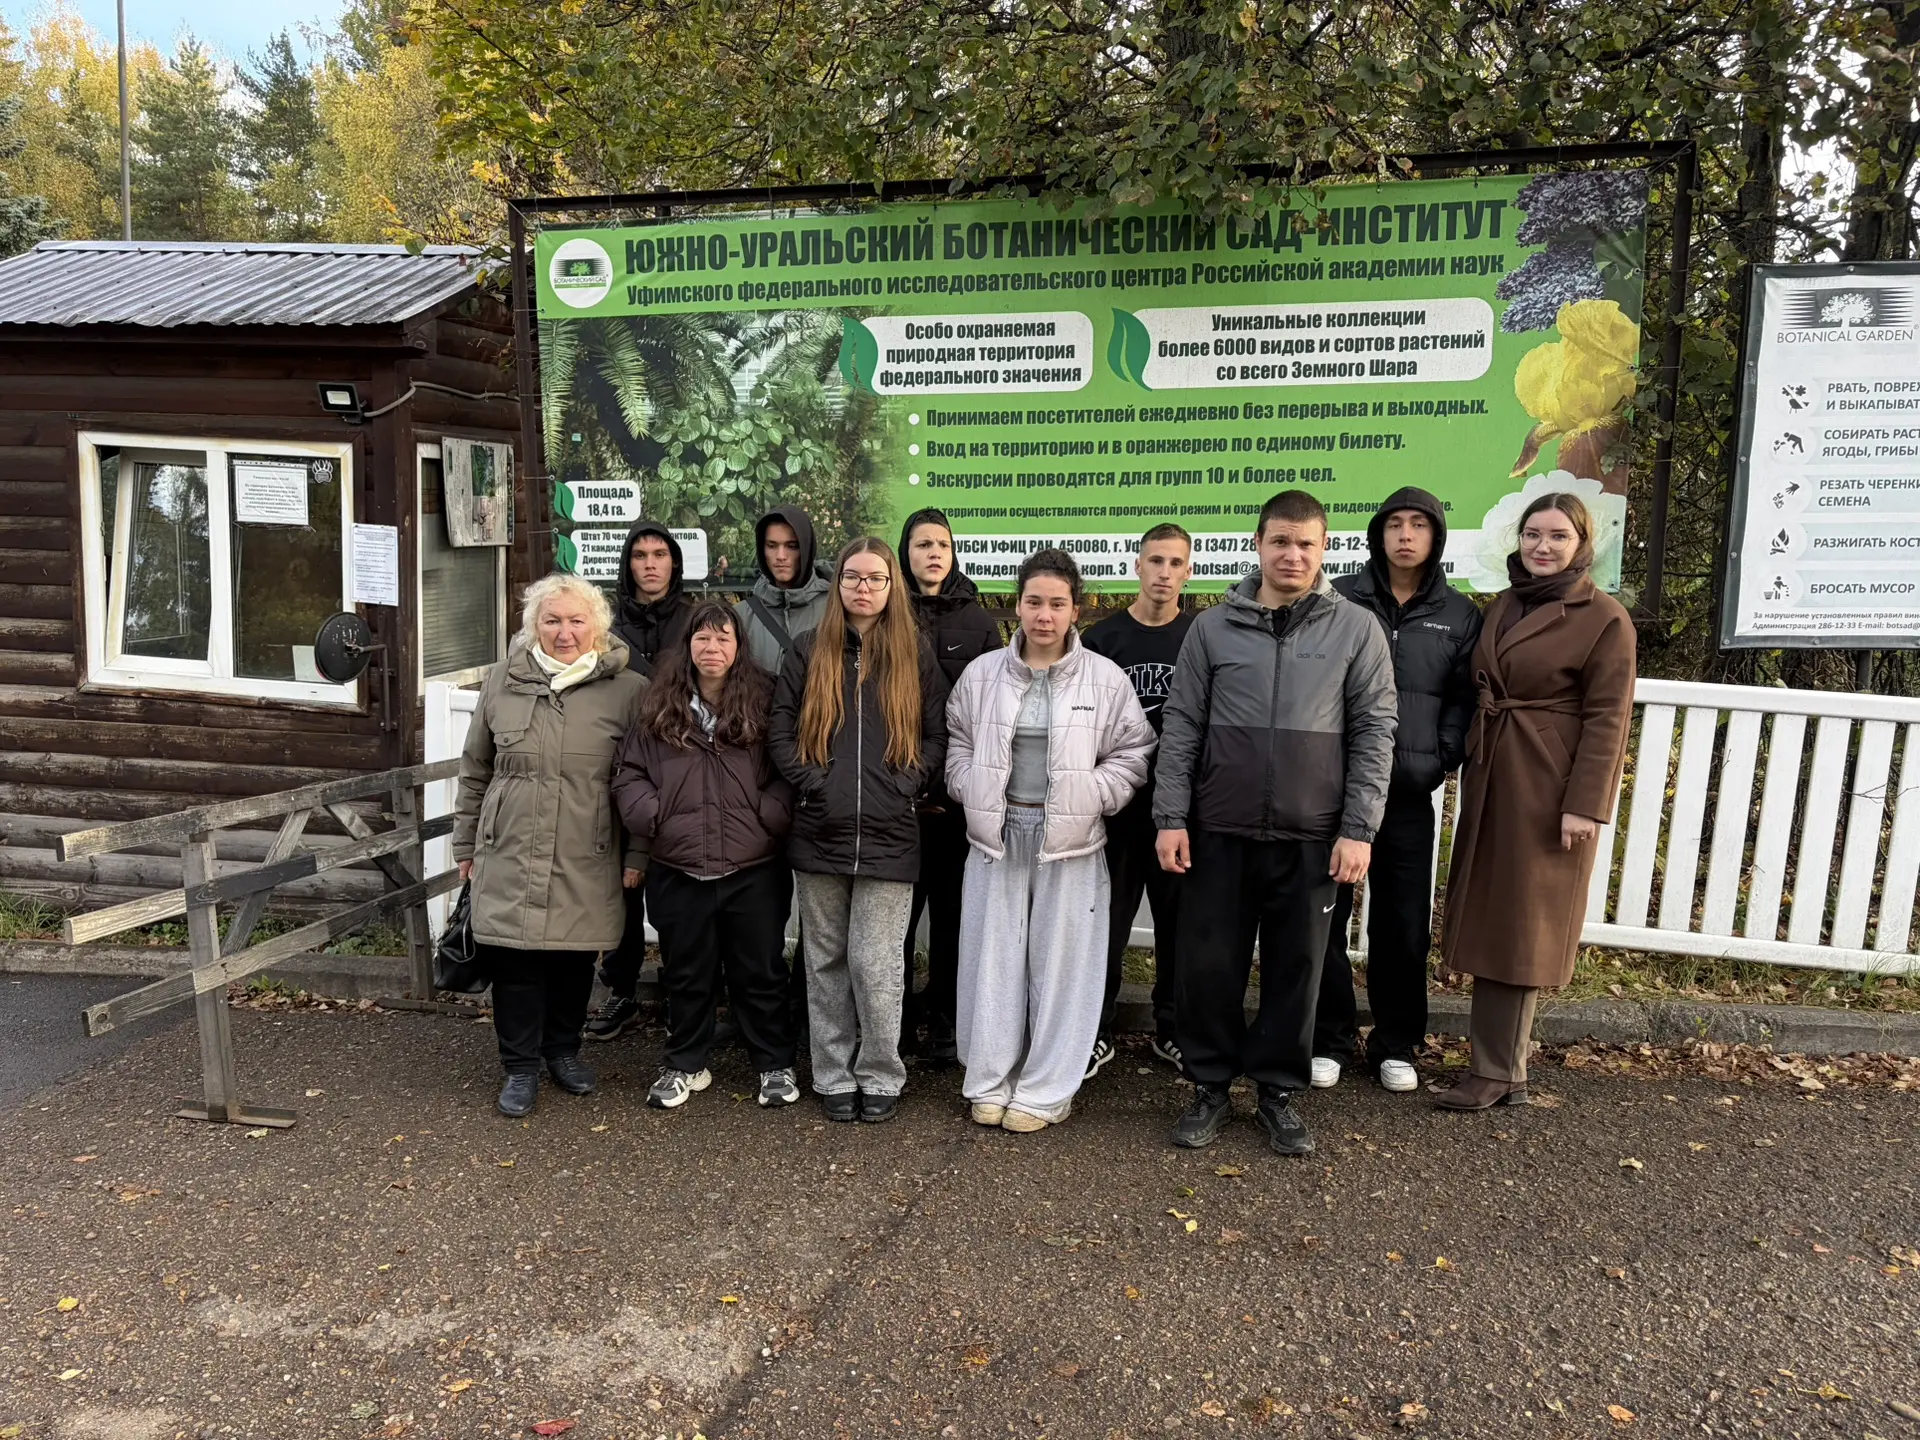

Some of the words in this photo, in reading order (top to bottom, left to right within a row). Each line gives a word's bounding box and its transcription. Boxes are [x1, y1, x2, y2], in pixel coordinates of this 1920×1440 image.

[624, 217, 934, 275] ЮЖНО-УРАЛЬСКИЙ
[1226, 199, 1508, 254] САД-ИНСТИТУТ
[626, 284, 734, 307] Уфимского
[738, 276, 883, 302] федерального
[887, 269, 1106, 296] исследовательского
[1111, 266, 1187, 290] центра
[1191, 257, 1324, 285] Российской
[1328, 258, 1445, 281] академии
[1450, 254, 1505, 276] наук
[1211, 312, 1323, 332] Уникальные
[1326, 309, 1427, 328] коллекции
[905, 322, 954, 340] Особо
[956, 321, 1056, 340] охраняемая
[1776, 329, 1853, 344] BOTANICAL
[1855, 329, 1914, 342] GARDEN
[1158, 339, 1210, 357] более
[1213, 337, 1257, 356] 6000
[1260, 338, 1316, 356] видов
[1319, 337, 1331, 353] и
[1334, 335, 1395, 354] сортов
[1398, 329, 1486, 351] растений
[886, 346, 976, 364] природная
[979, 344, 1076, 362] территория
[1216, 363, 1237, 380] со
[1240, 362, 1288, 380] всего
[1291, 359, 1365, 379] Земного
[1368, 358, 1418, 377] Шара
[879, 369, 999, 388] федерального
[1002, 367, 1082, 384] значения
[1827, 382, 1871, 394] РВАТЬ,
[1826, 400, 1836, 410] И
[926, 409, 1023, 428] Принимаем
[1026, 405, 1136, 426] посетителей
[1138, 403, 1240, 423] ежедневно
[1242, 401, 1274, 420] без
[1277, 400, 1368, 420] перерыва
[1371, 400, 1384, 416] и
[1387, 399, 1489, 418] выходных.
[1823, 429, 1890, 440] СОБИРАТЬ
[926, 440, 967, 458] Вход
[969, 441, 989, 457] на
[992, 440, 1095, 458] территорию
[1097, 439, 1109, 455] и
[1112, 439, 1123, 454] в
[1125, 436, 1228, 455] оранжерею
[1231, 437, 1253, 452] по
[1256, 434, 1336, 453] единому
[1339, 432, 1406, 450] билету.
[1821, 446, 1872, 459] ЯГОДЫ,
[1874, 445, 1919, 456] ГРИБЫ
[926, 471, 1013, 489] Экскурсии
[1016, 470, 1116, 489] проводятся
[1118, 470, 1151, 487] для
[1155, 469, 1203, 486] групп
[1205, 467, 1225, 484] 10
[1227, 468, 1240, 484] и
[1243, 466, 1297, 483] более
[1299, 467, 1337, 483] чел.
[1819, 479, 1865, 490] РЕЗАТЬ
[577, 486, 634, 500] Площадь
[1818, 496, 1871, 507] СЕМЕНА
[587, 504, 609, 517] 18,4
[611, 506, 626, 516] га.
[942, 507, 1008, 518] территории
[1009, 505, 1107, 518] осуществляются
[1109, 503, 1178, 518] пропускной
[1180, 503, 1221, 517] режим
[1223, 504, 1232, 514] и
[1233, 504, 1263, 515] охра
[580, 532, 601, 541] Штат
[602, 532, 611, 541] 70
[612, 533, 628, 541] чел
[669, 532, 700, 541] октора,
[1813, 537, 1887, 549] РАЗЖИГАТЬ
[581, 544, 590, 552] 21
[591, 545, 624, 553] кандид
[991, 539, 1027, 554] УФИЦ
[1029, 539, 1054, 553] РАН
[1058, 539, 1111, 554] 450080,
[1124, 539, 1141, 554] Уф
[1193, 538, 1202, 551] 8
[1205, 537, 1239, 552] (347)
[582, 555, 621, 565] Директор
[965, 562, 1022, 577] Мендел
[1081, 564, 1116, 577] корп.
[1119, 562, 1127, 576] 3
[1193, 561, 1259, 575] botsad@a
[1810, 583, 1867, 594] БРОСАТЬ
[1870, 583, 1915, 594] МУСОР
[1753, 611, 1763, 619] За
[1764, 612, 1810, 620] нарушение
[1811, 612, 1872, 620] установленных
[1873, 612, 1903, 620] правил
[1752, 622, 1817, 630] Администрация
[1296, 651, 1326, 659] adias
[1122, 662, 1176, 698] IK
